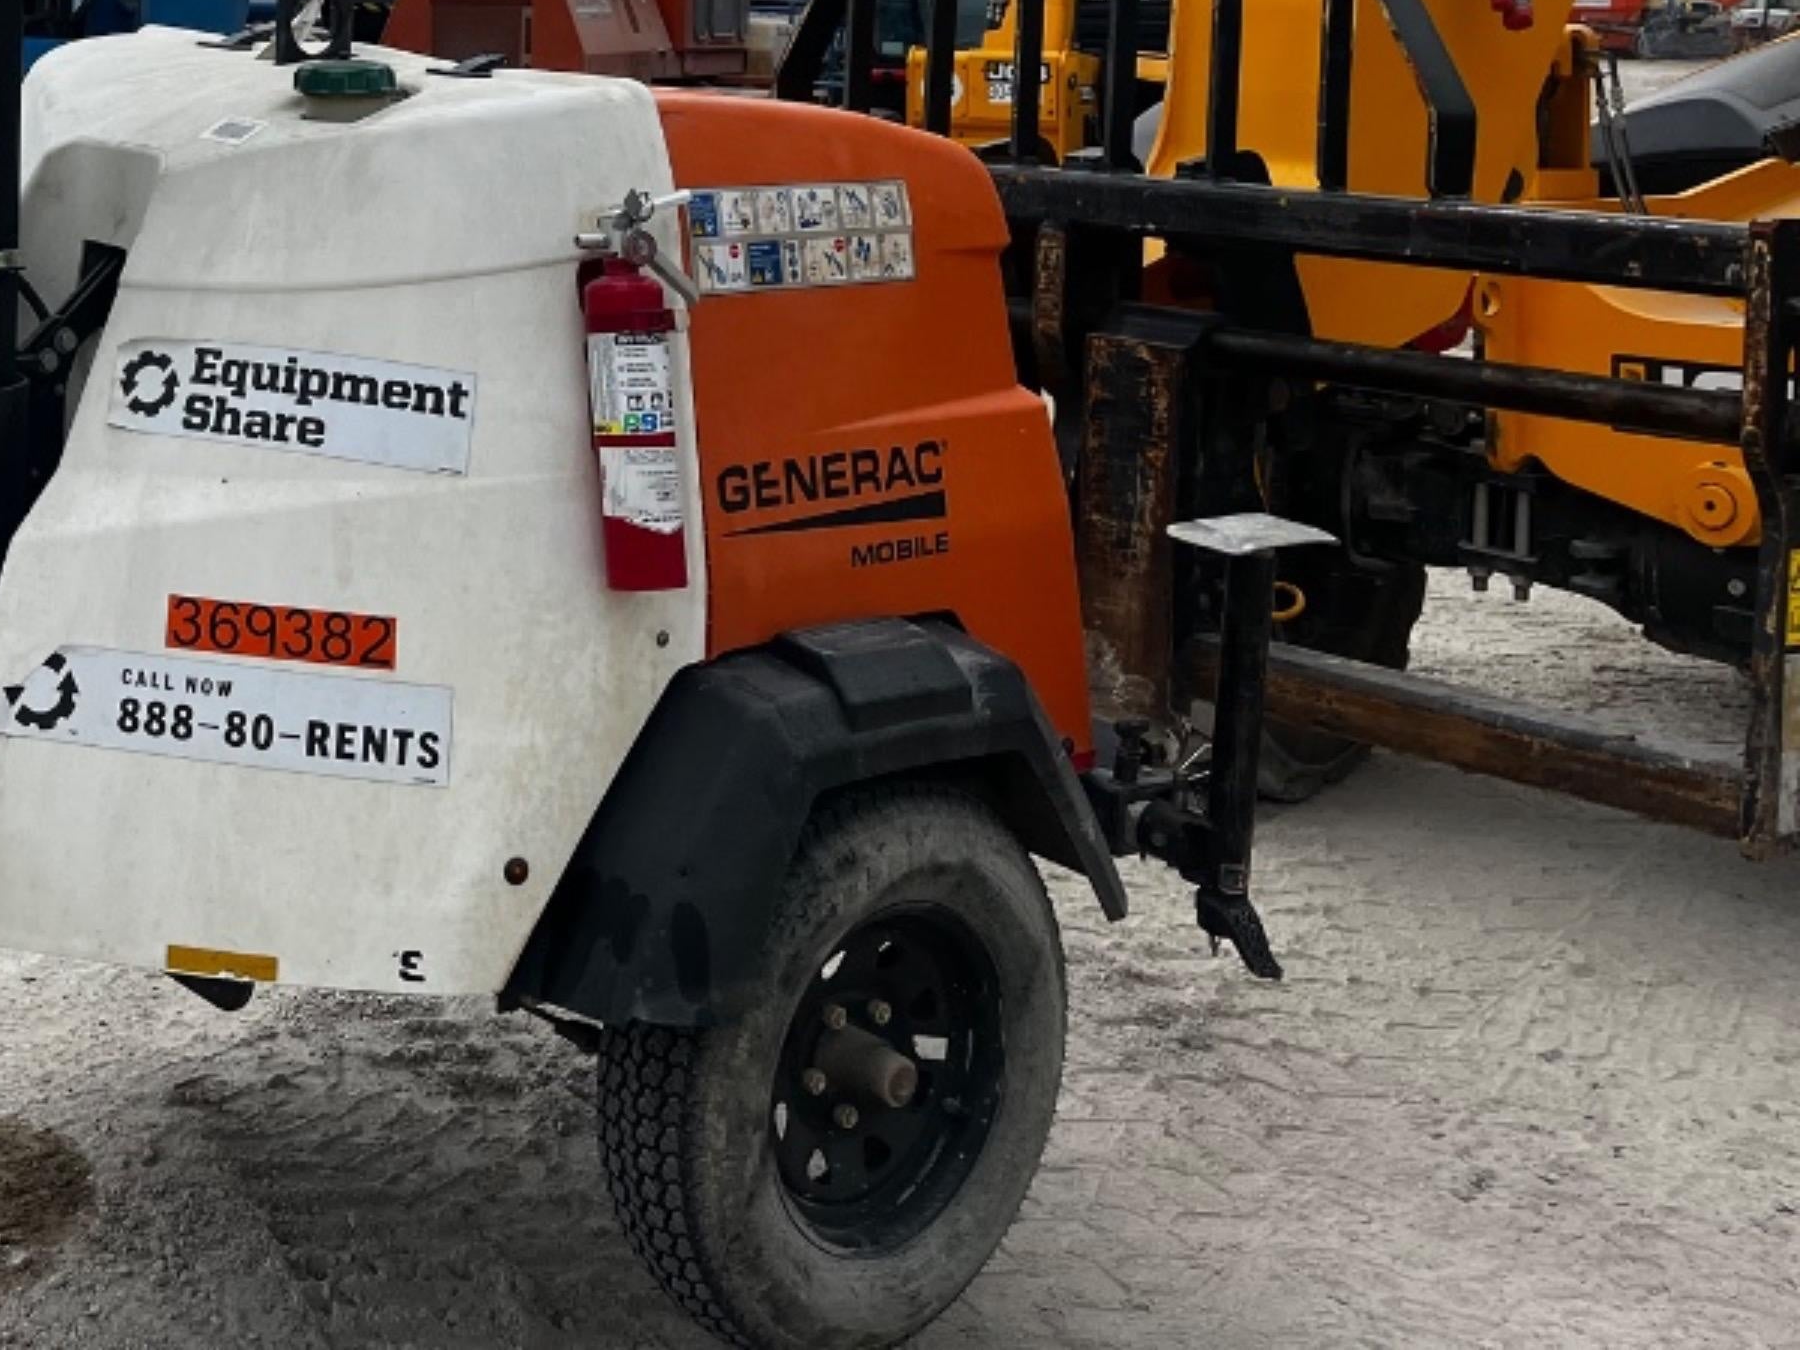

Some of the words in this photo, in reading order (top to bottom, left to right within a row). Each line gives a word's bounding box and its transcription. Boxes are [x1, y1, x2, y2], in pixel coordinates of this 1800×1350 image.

[189, 347, 470, 419] Equipment
[181, 393, 326, 448] Share
[716, 439, 943, 514] GENERAC
[851, 531, 949, 567] MOBILE
[172, 599, 393, 667] 369382
[121, 667, 175, 692] CALL
[185, 676, 234, 698] NOW
[117, 697, 440, 769] 888-80-RENTS
